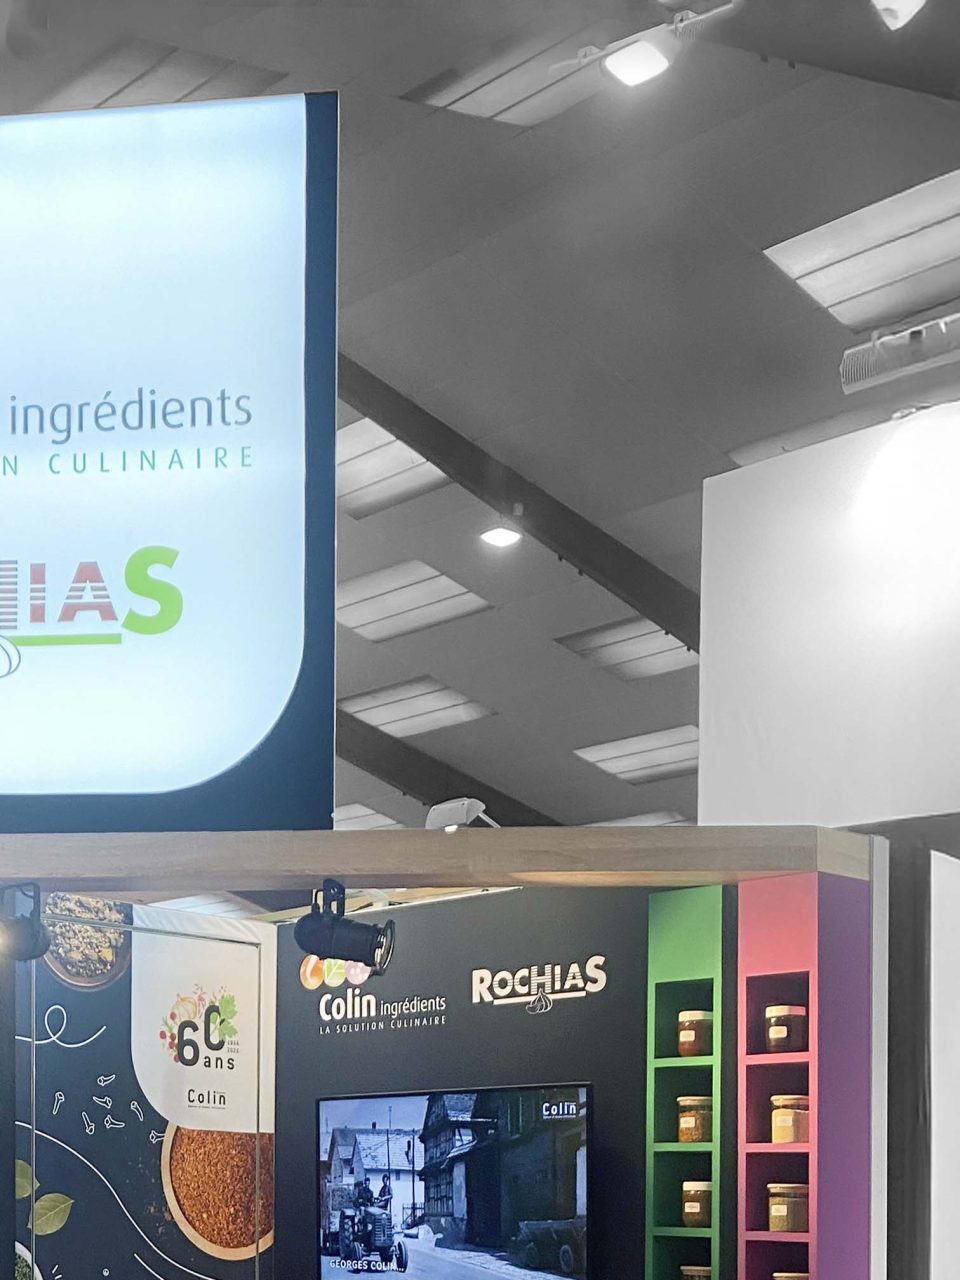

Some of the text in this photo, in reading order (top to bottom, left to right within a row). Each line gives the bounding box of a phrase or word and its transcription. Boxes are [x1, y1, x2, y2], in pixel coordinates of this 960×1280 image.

[9, 387, 252, 445] ingrédients
[48, 446, 253, 475] CULINAIRE
[471, 955, 607, 1004] ROCHIAS
[319, 988, 446, 1021] Colin ingrédients
[320, 1015, 446, 1035] LA SOLUTION CULINAIRE
[203, 1056, 235, 1070] ans
[187, 1088, 227, 1106] Colin
[542, 1102, 577, 1116] Colin
[329, 1259, 368, 1270] GEORGES
